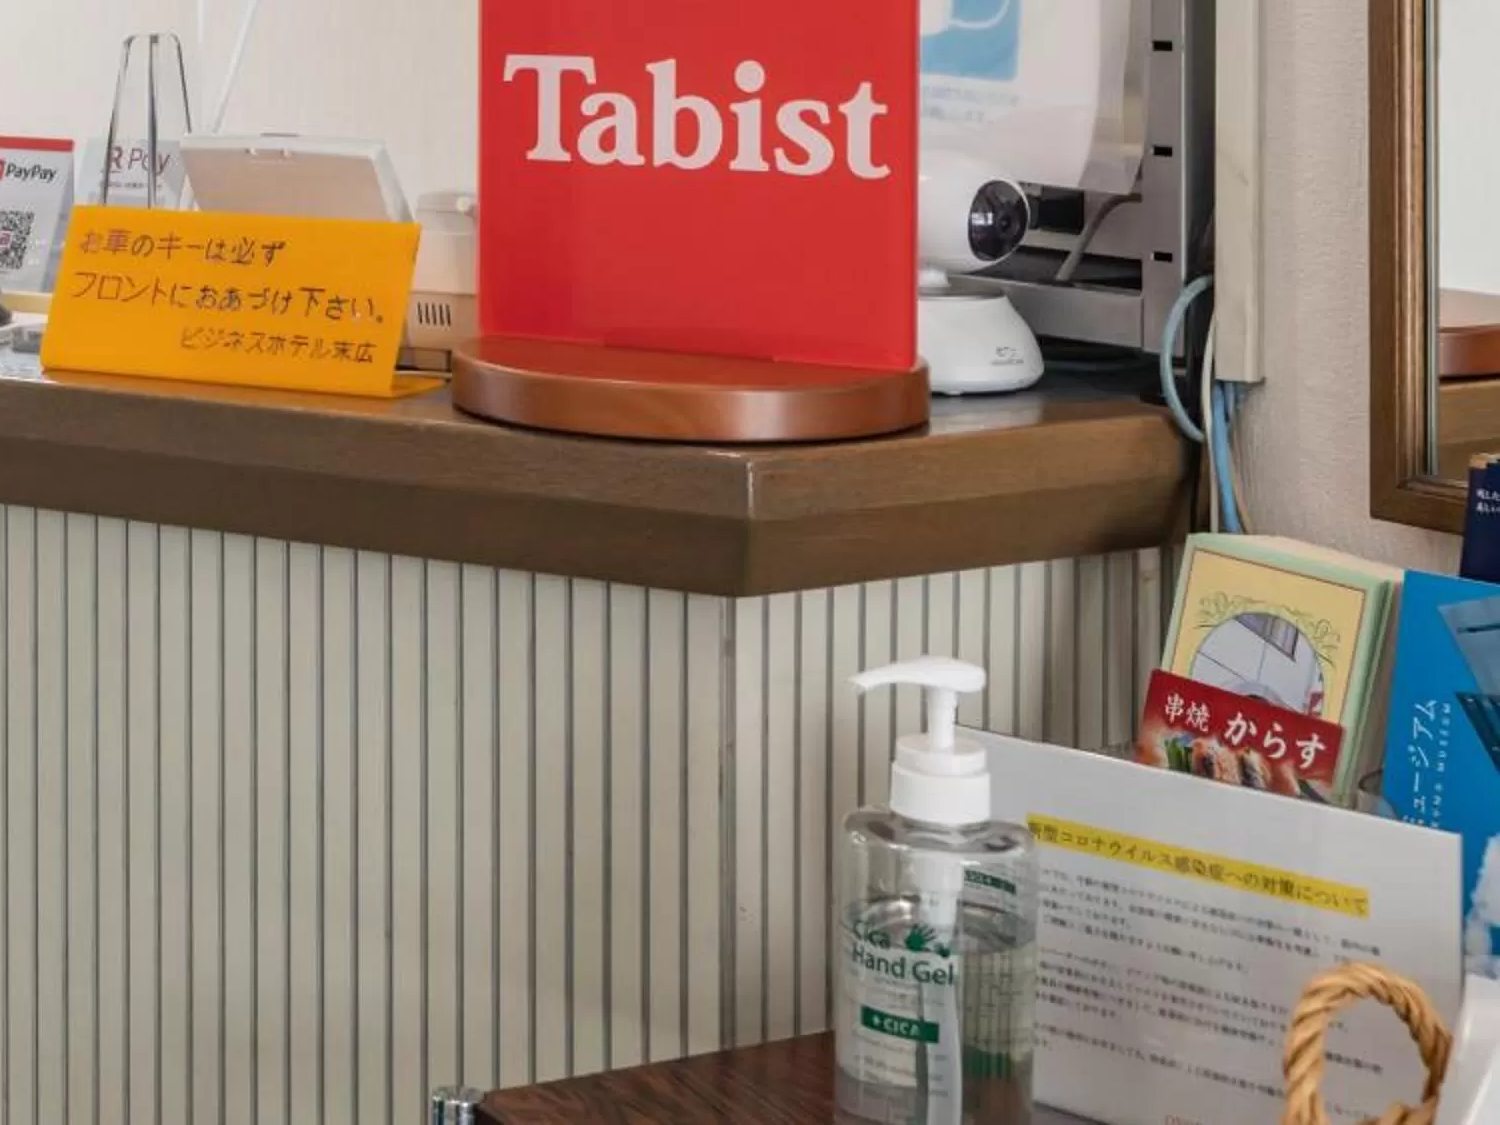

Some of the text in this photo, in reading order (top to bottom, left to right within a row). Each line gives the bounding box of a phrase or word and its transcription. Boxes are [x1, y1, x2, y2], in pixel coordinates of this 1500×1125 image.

[502, 53, 891, 180] Tabist
[4, 161, 59, 183] PayPay
[79, 228, 286, 267] お車のキーは必ず
[71, 271, 386, 324] フロントにおあづけ下さい。
[179, 326, 379, 365] ビジネスホテル末広
[1164, 692, 1327, 770] 串焼 からす
[851, 941, 954, 986] Hand Gel
